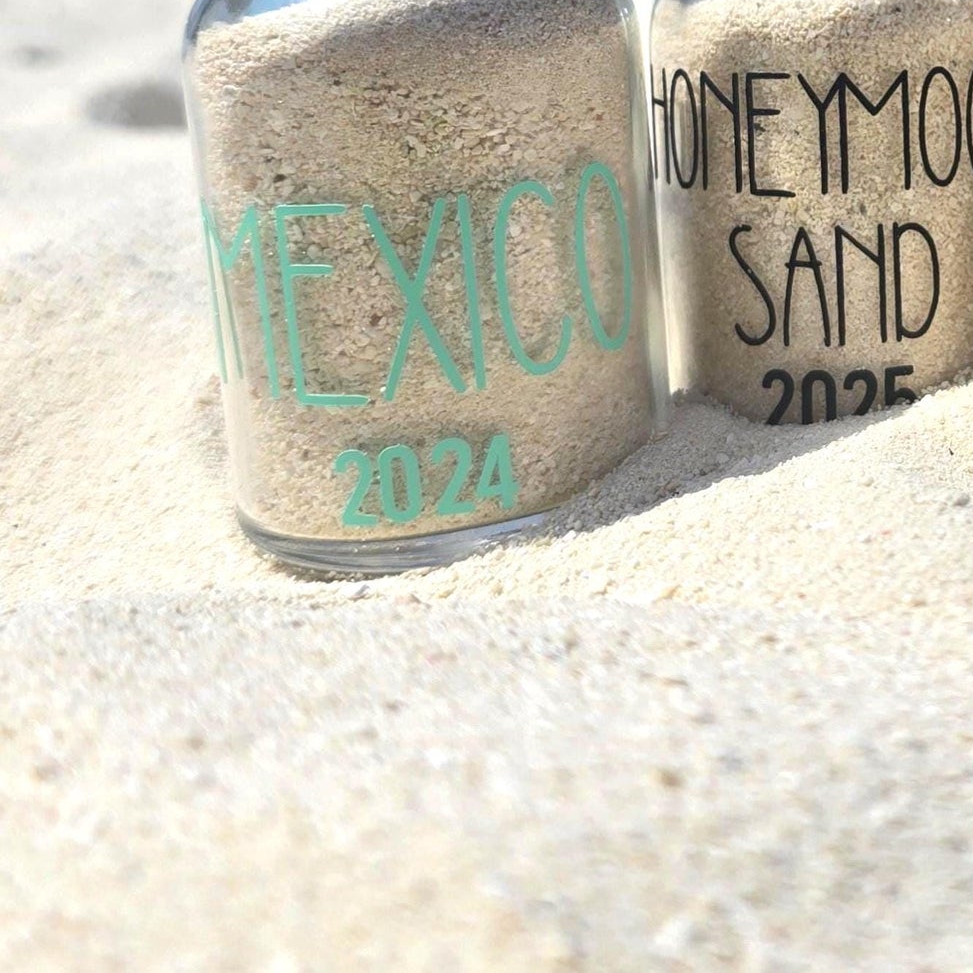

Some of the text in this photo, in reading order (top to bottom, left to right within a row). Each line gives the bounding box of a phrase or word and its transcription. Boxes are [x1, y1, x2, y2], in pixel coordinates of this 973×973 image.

[199, 162, 633, 407] MEXICO
[728, 222, 940, 346] SAND
[334, 434, 520, 527] 2024
